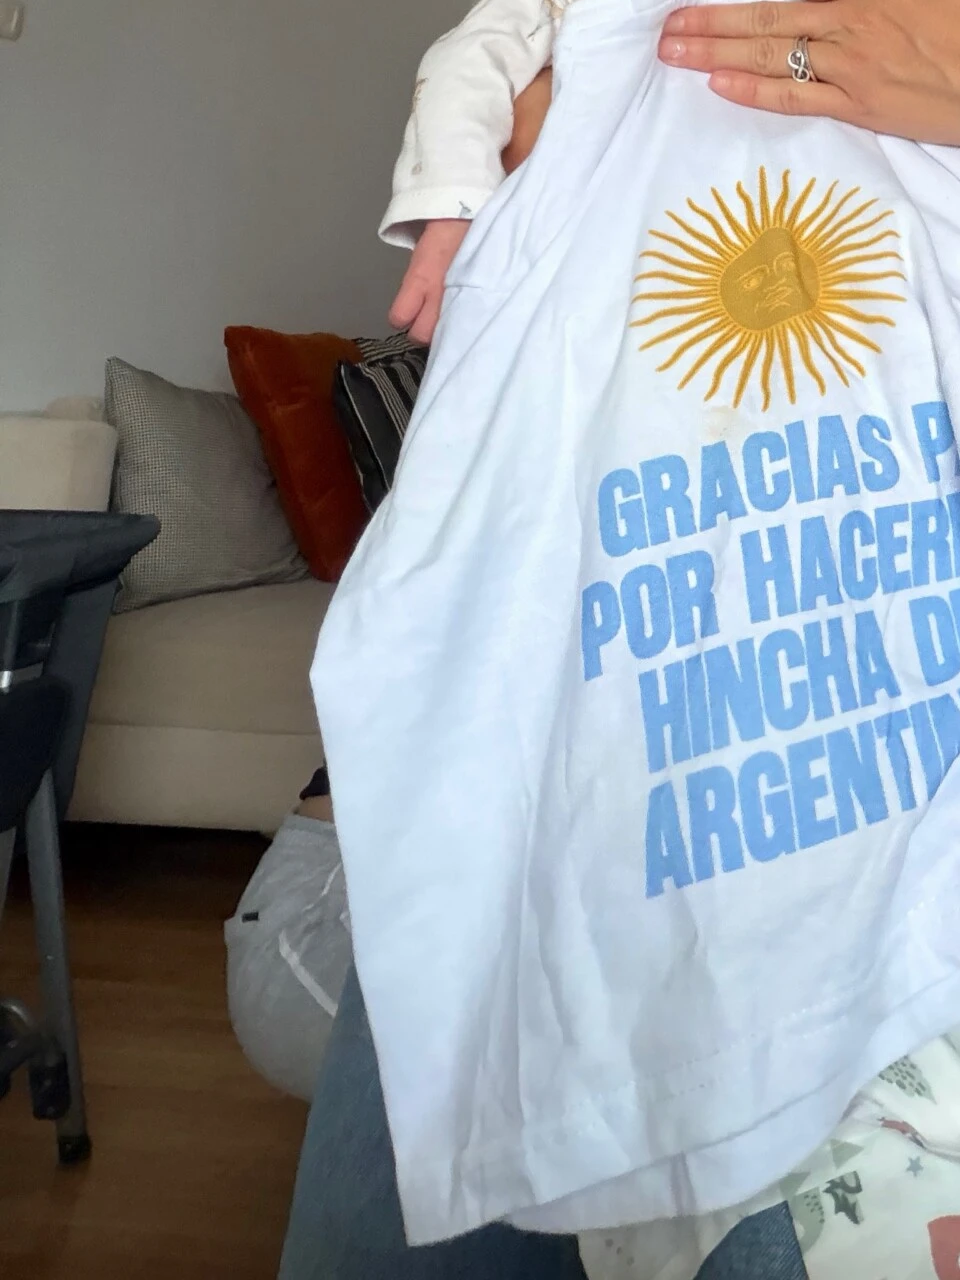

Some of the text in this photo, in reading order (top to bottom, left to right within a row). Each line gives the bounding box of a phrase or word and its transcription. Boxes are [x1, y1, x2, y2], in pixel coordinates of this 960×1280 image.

[598, 414, 900, 557] GRACIAS
[581, 549, 719, 681] POR
[638, 610, 901, 773] HINCHA
